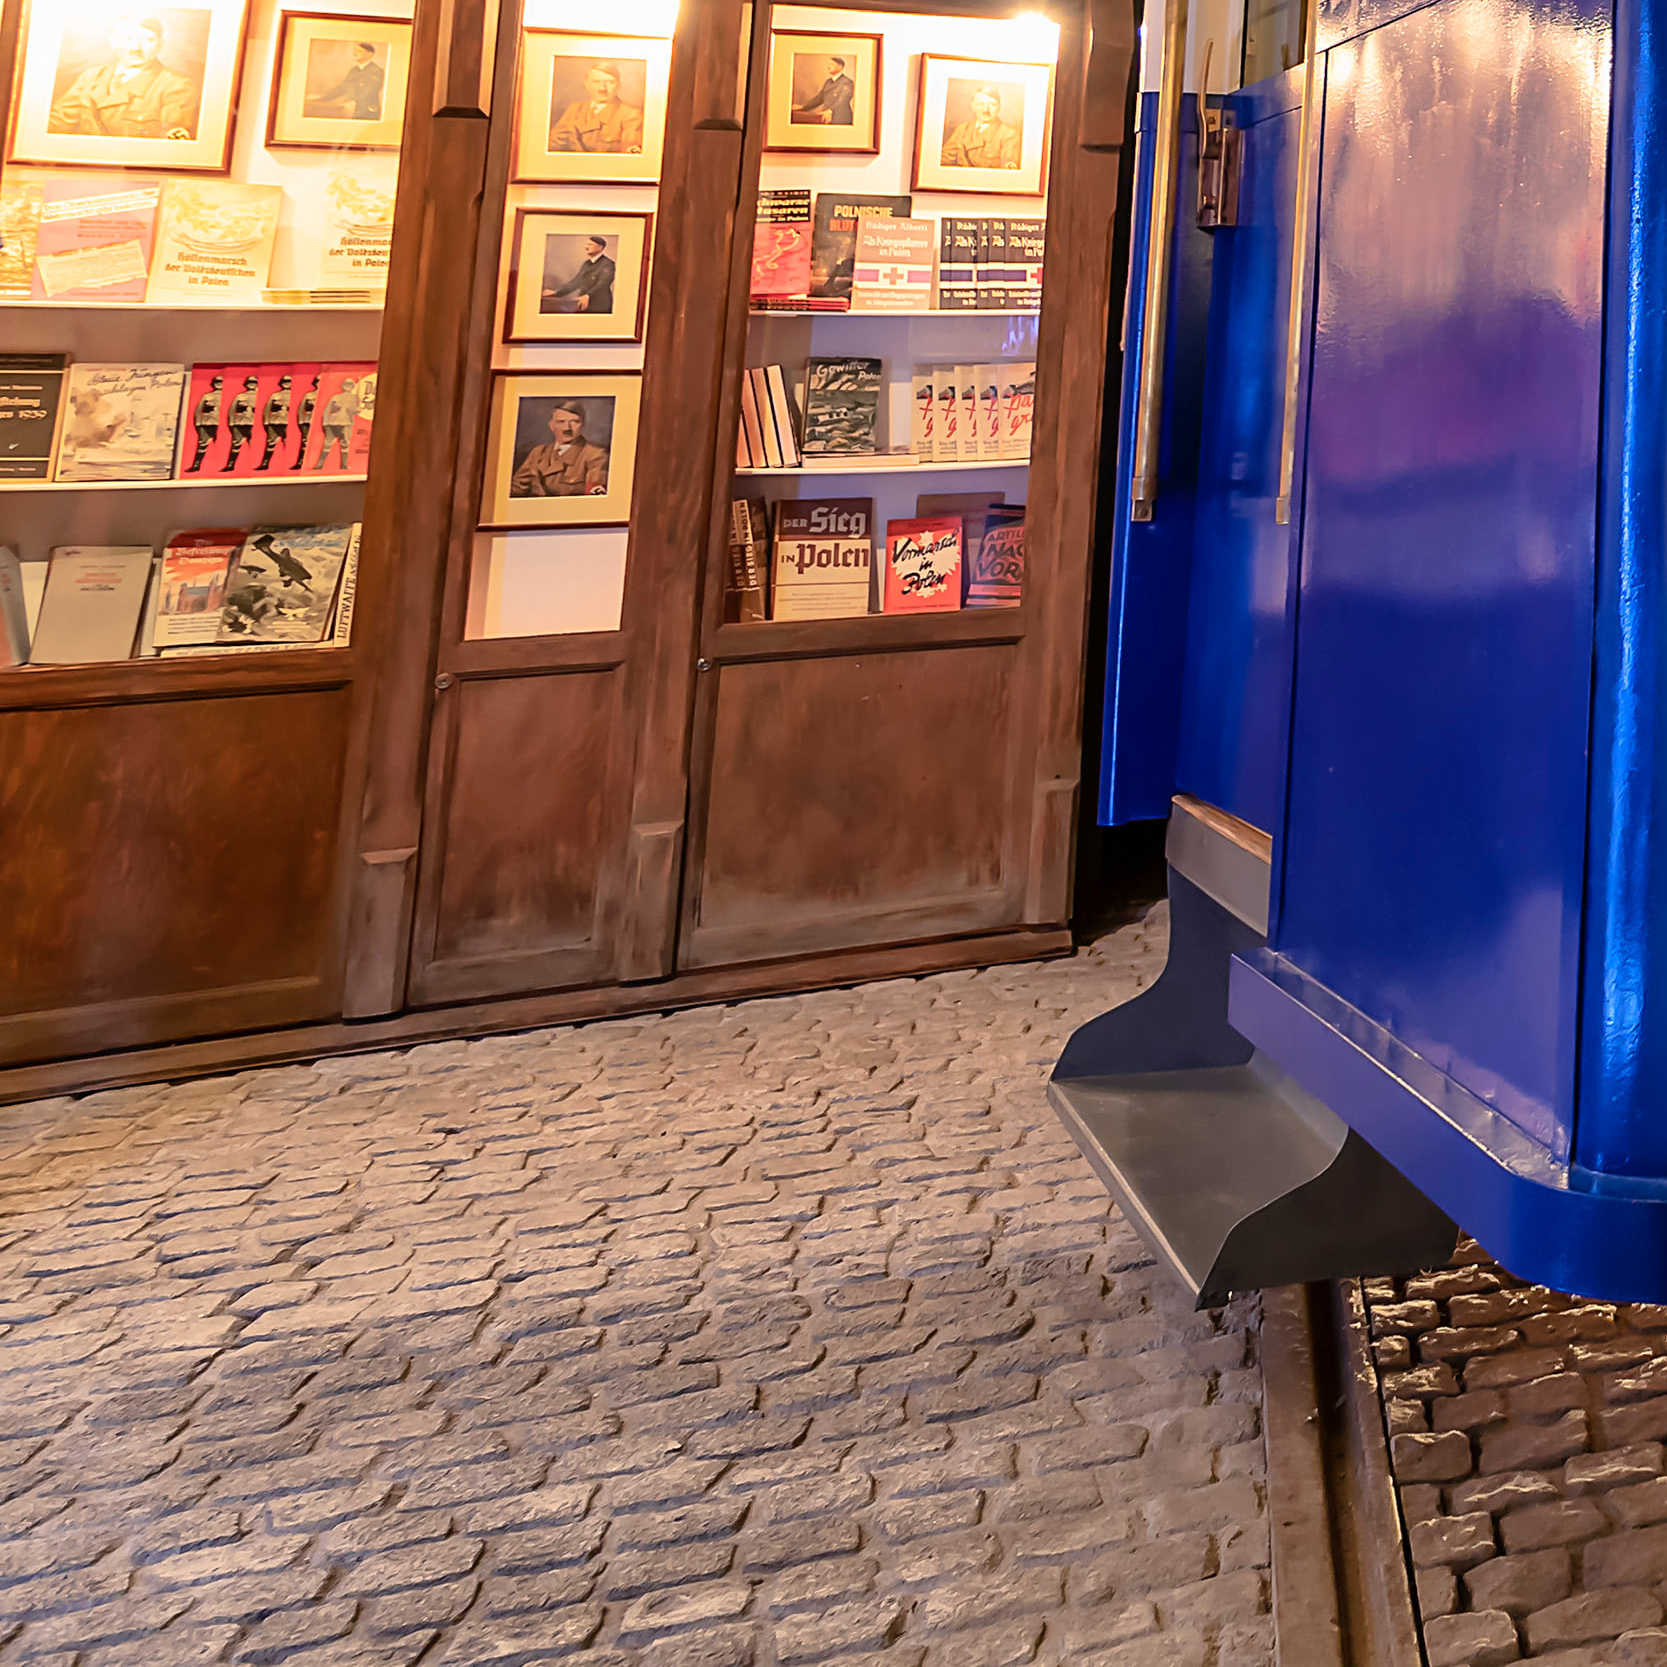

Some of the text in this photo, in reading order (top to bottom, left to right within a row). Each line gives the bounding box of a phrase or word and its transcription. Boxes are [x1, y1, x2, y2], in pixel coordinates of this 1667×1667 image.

[816, 360, 870, 377] Gewitter
[784, 507, 866, 538] DER Sieg
[745, 545, 755, 566] SIEG
[781, 543, 869, 574] IN Polen
[747, 568, 757, 586] DER
[337, 577, 355, 638] LUFTWAFFE
